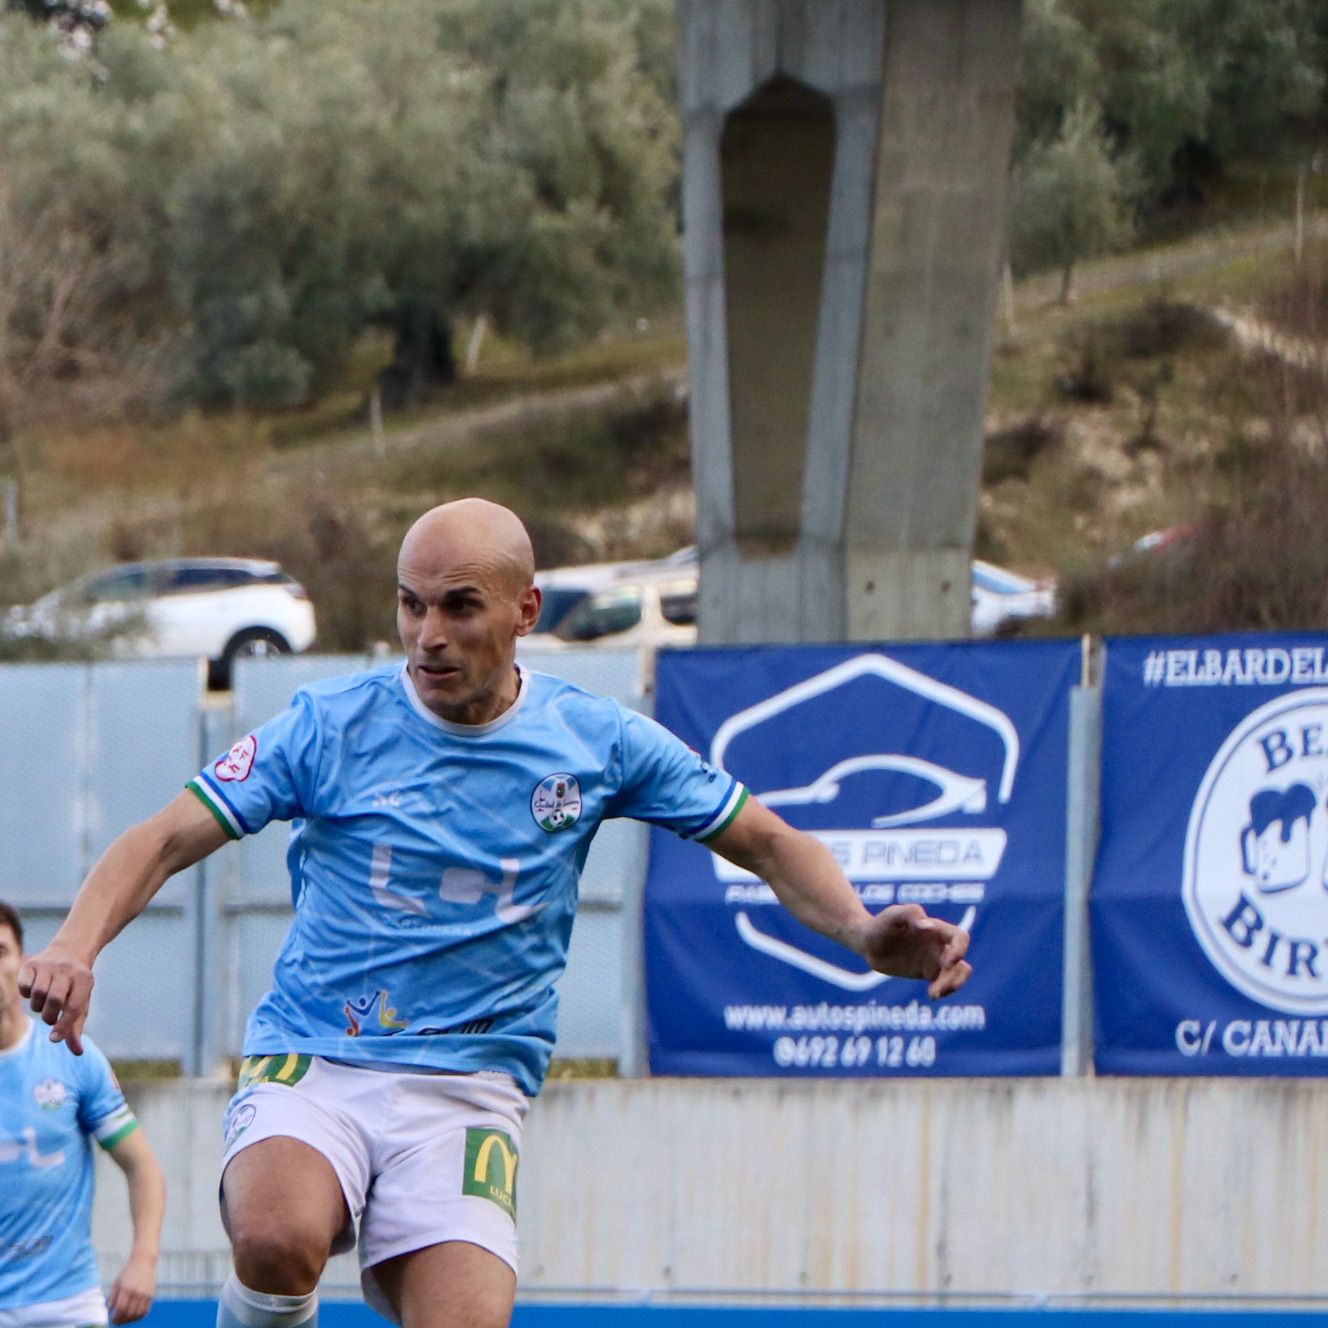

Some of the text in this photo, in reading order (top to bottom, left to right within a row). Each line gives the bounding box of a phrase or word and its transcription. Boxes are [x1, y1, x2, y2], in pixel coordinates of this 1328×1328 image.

[862, 840, 984, 865] PINEDA
[1222, 893, 1328, 977] BIR
[724, 1001, 986, 1034] www.autospineda.com
[841, 1036, 872, 1067] 69
[877, 1036, 904, 1067] 12
[1222, 1019, 1328, 1058] CANA
